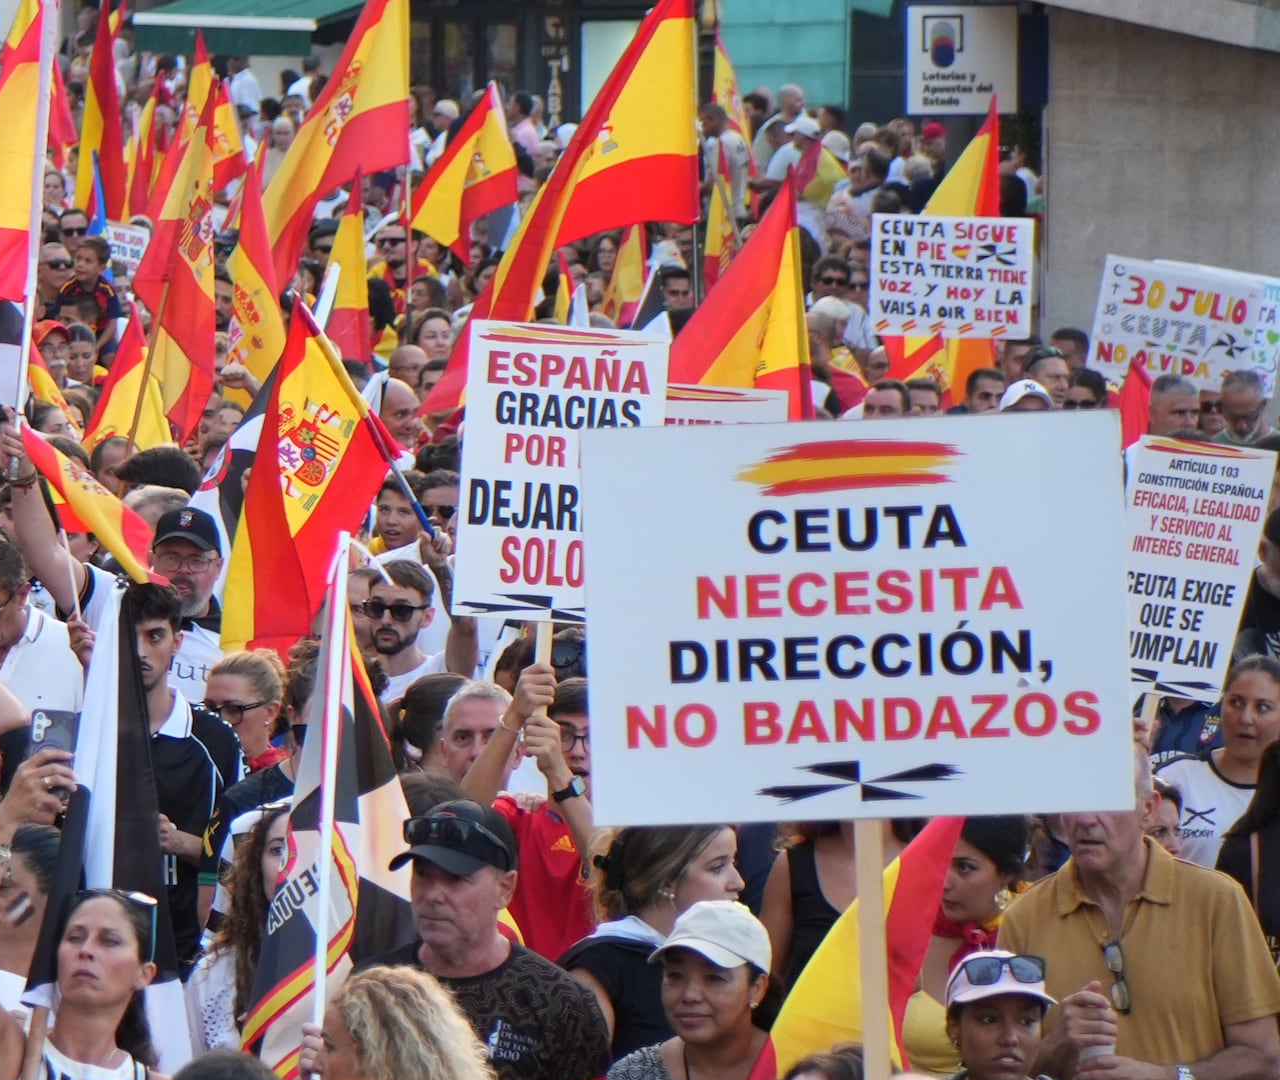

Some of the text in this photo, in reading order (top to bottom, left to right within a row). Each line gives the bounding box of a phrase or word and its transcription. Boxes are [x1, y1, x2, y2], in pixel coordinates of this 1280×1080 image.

[922, 97, 959, 106] Estado
[880, 219, 1017, 243] CEUTA SIGUE
[880, 240, 946, 260] EN PIE
[880, 260, 1027, 285] ESTA TIERRA TIENE
[880, 299, 1018, 324] VAIS A OIR BIEN
[946, 286, 985, 302] HOY
[995, 289, 1023, 305] LA
[1123, 275, 1247, 325] 30 JULIO
[1121, 314, 1207, 346] CEUTA
[487, 350, 651, 395] ESPAÑA
[1096, 341, 1210, 378] NO OLVIDA
[495, 391, 641, 430] GRACIAS
[503, 433, 567, 467] POR
[1168, 458, 1240, 479] ARTÍCULO 103
[1138, 472, 1264, 500] CONSTITUCIÓN ESPAÑOLA
[468, 478, 583, 532] DEJAR
[1133, 489, 1261, 523] EFICACIA, LEGALIDAD
[747, 503, 967, 555] CEUTA
[1150, 514, 1233, 542] Y SERVICIO AL
[1132, 535, 1240, 566] INTERÉS GENERAL
[695, 565, 1024, 620] NECESITA
[1181, 578, 1236, 607] EXIGE
[1140, 602, 1204, 633] QUE SE
[669, 619, 1053, 684] DIRECCIÓN,
[1130, 630, 1219, 669] UMPLAN
[626, 690, 1102, 749] NO BANDAZOS
